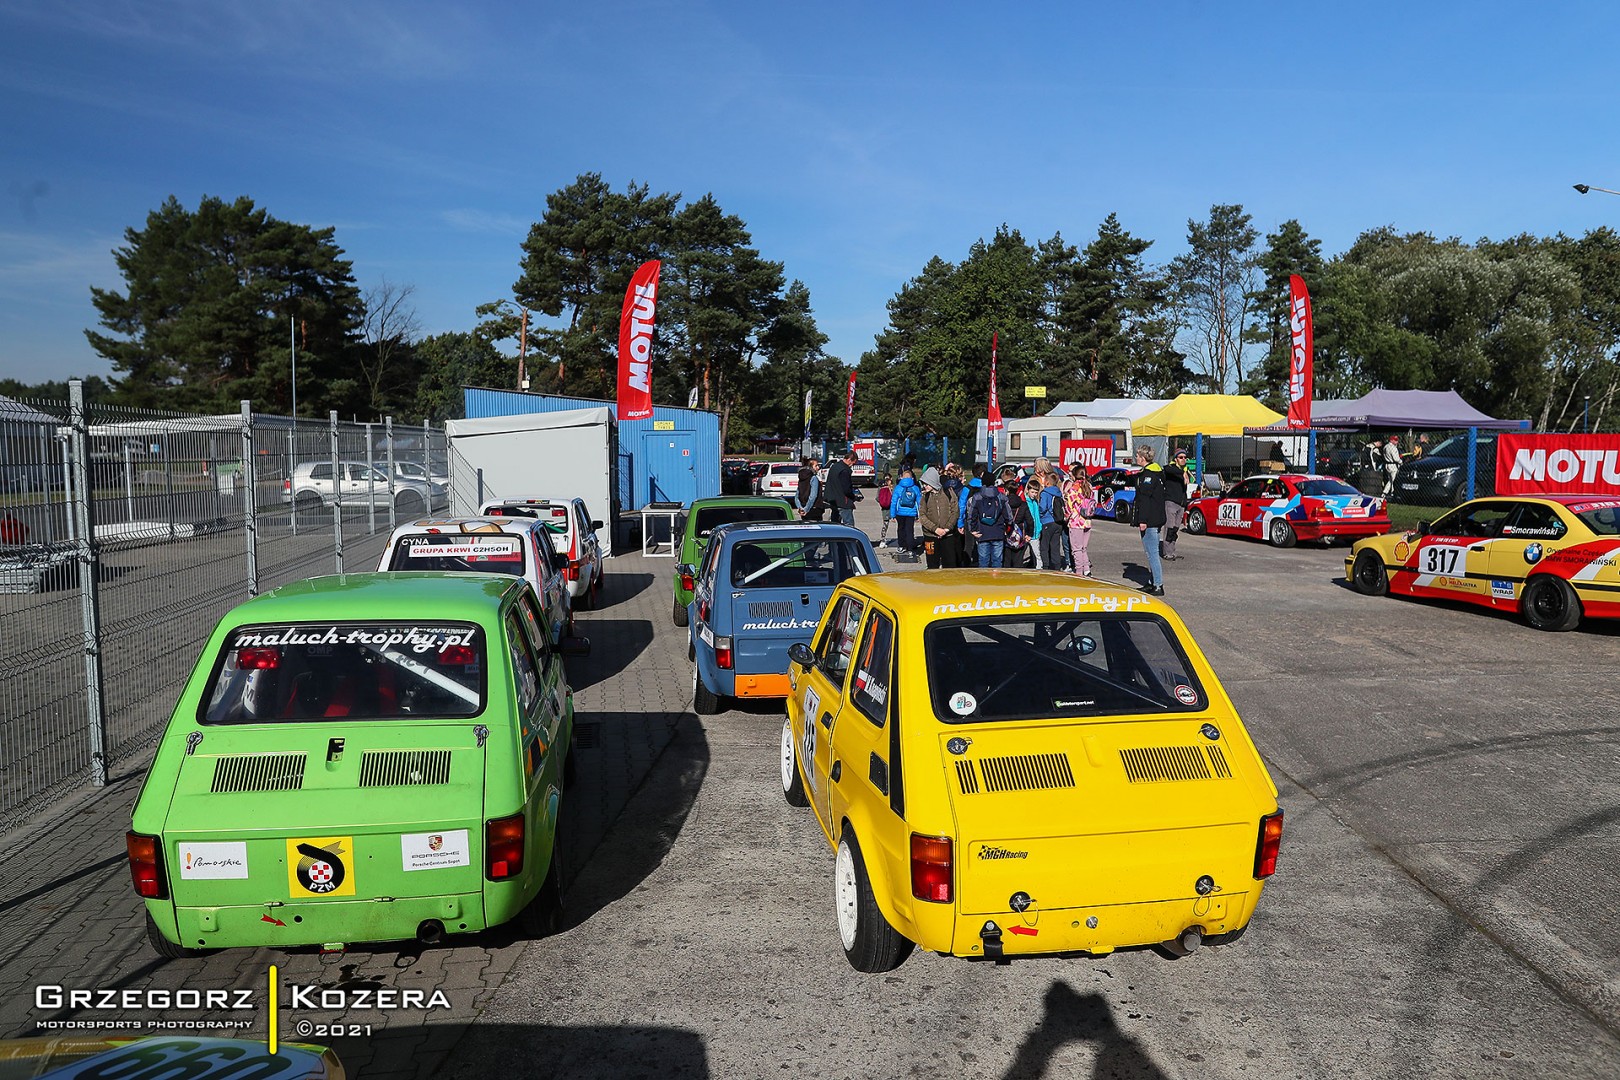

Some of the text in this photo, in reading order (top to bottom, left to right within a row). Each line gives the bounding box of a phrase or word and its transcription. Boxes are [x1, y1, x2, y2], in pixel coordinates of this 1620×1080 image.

[628, 283, 655, 393] MOTUL
[1290, 295, 1306, 402] MOTUL
[1063, 447, 1107, 467] MOTUL
[1222, 505, 1236, 519] 321
[1216, 519, 1252, 528] MOTORSPORT
[1511, 526, 1559, 536] Smorawiński
[1427, 547, 1460, 574] 317
[933, 593, 1151, 614] maluch-trophy.pl
[235, 626, 475, 653] maluch-trophy.pl
[193, 856, 242, 867] Pomorskie
[412, 850, 460, 858] PORSCHE
[309, 881, 336, 892] PZM
